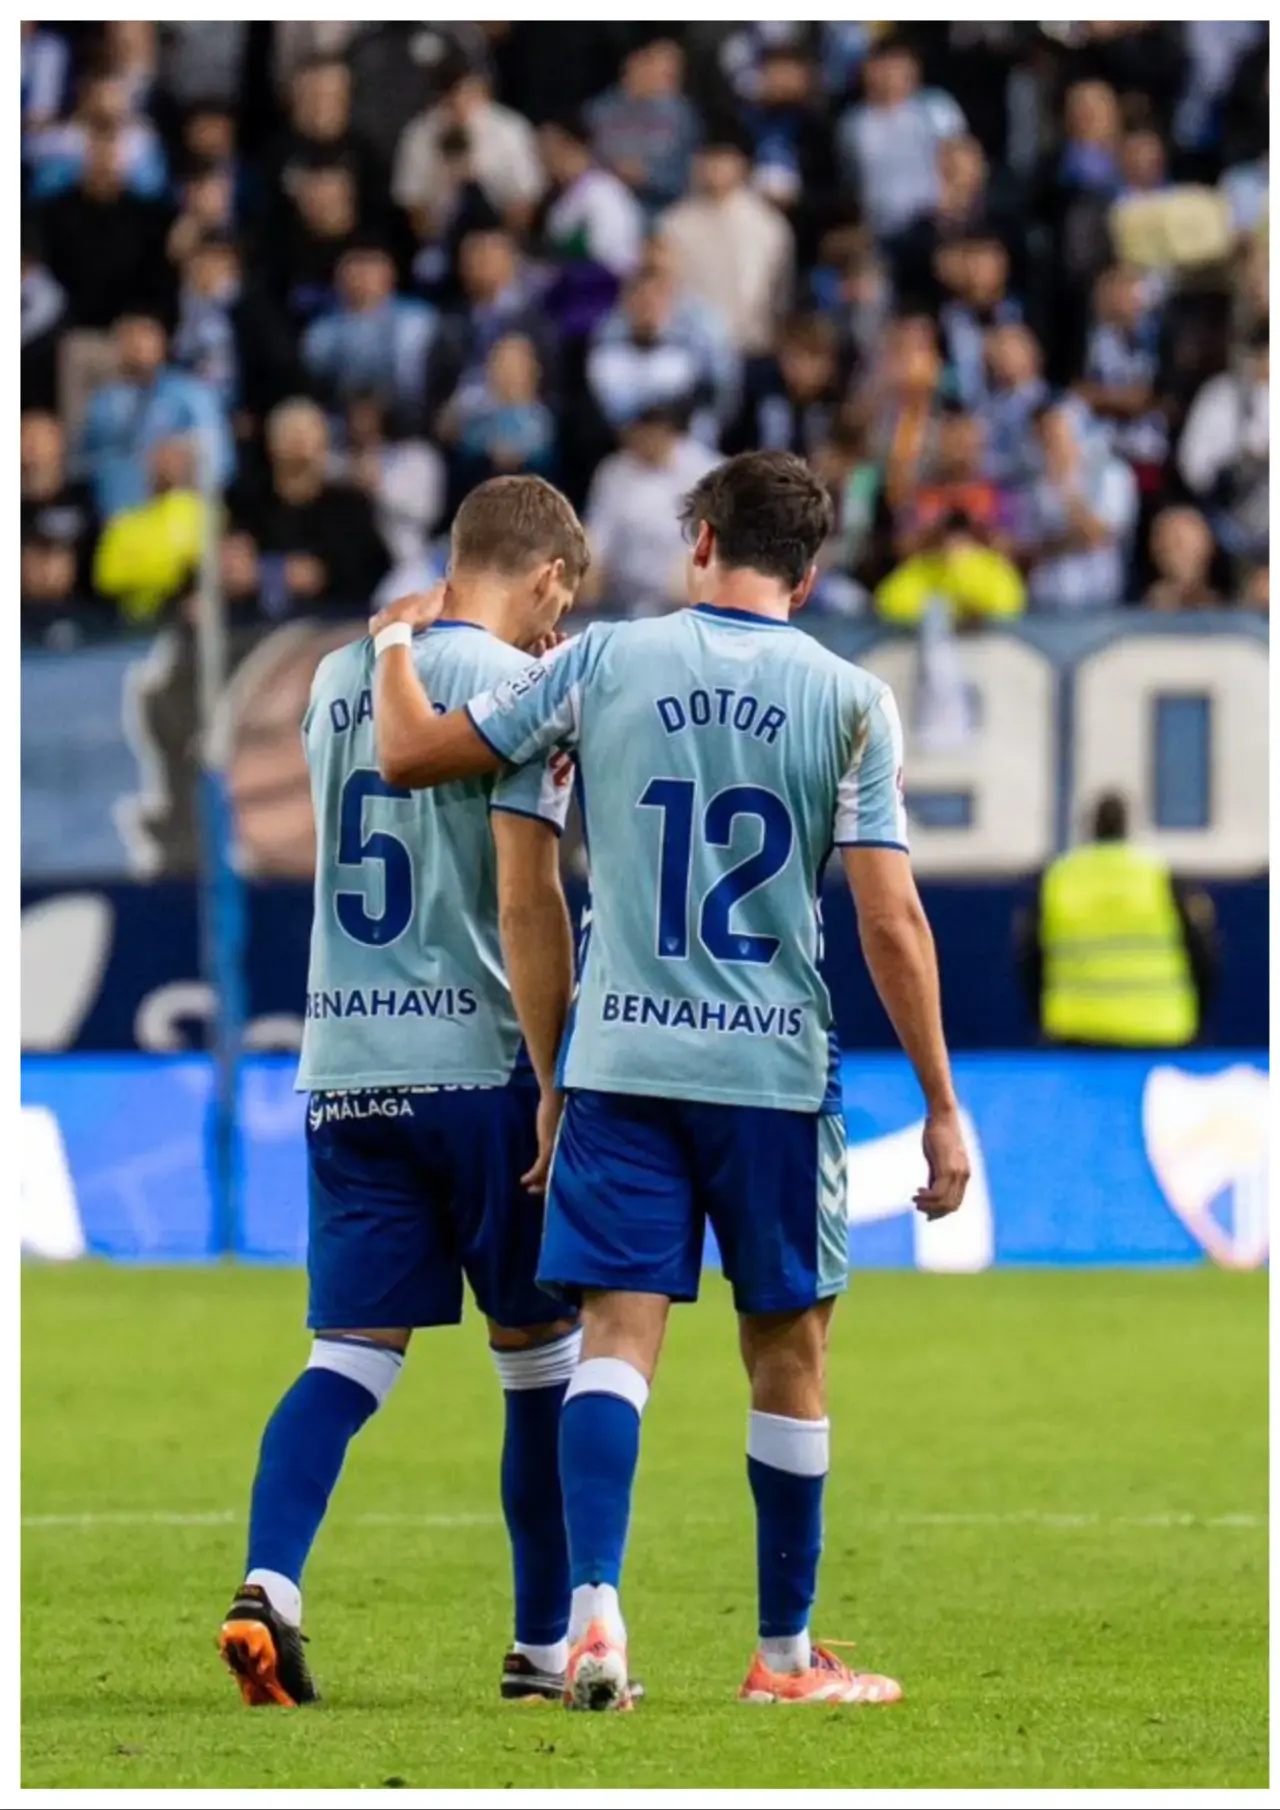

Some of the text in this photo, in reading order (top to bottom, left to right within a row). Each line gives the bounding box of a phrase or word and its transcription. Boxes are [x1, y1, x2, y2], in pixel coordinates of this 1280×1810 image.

[656, 687, 787, 744] DOTOR
[333, 767, 415, 948] 5
[635, 776, 796, 967] 12
[602, 993, 803, 1037] BENAHAVIS
